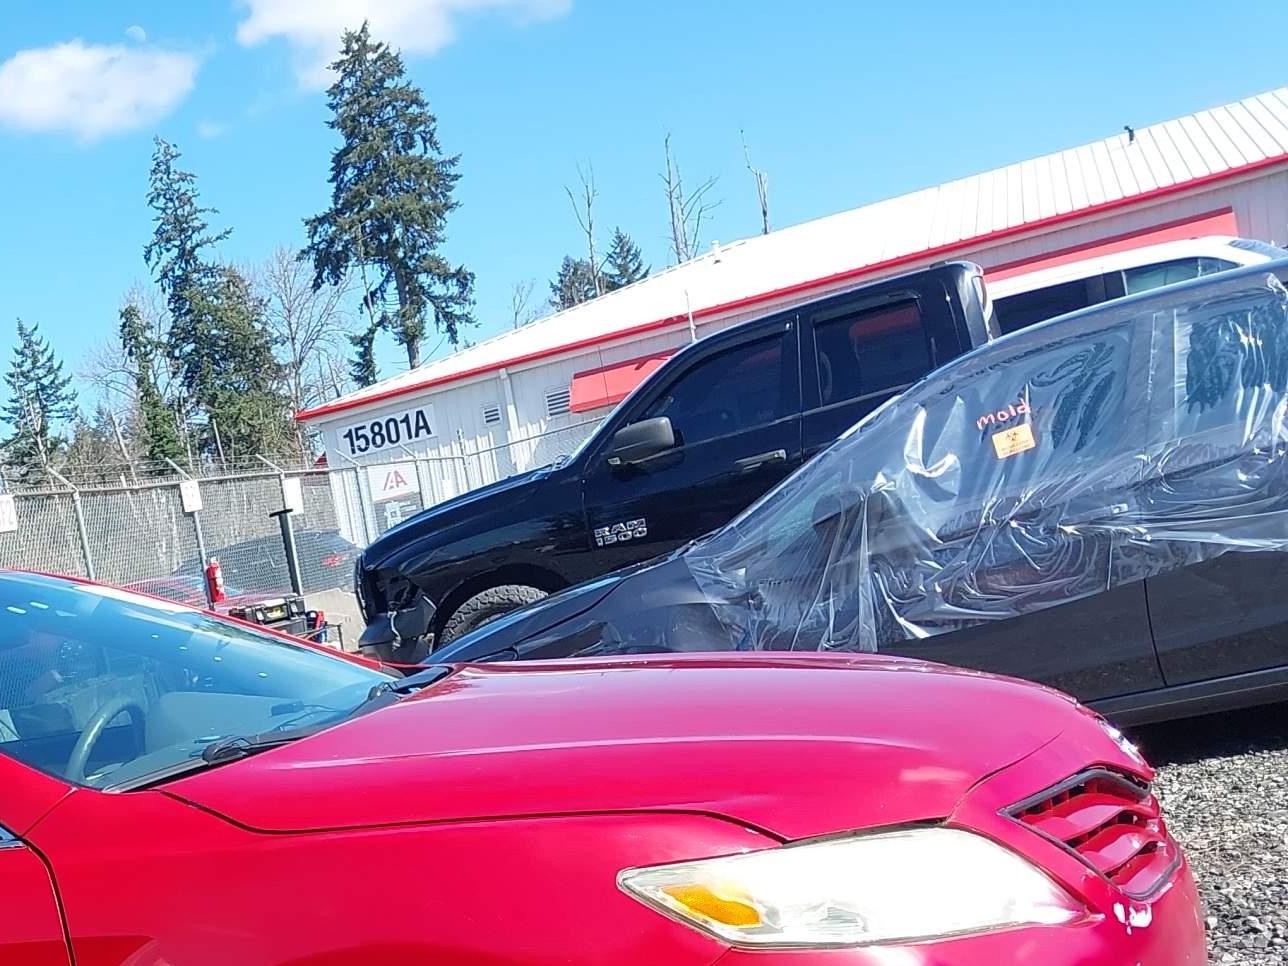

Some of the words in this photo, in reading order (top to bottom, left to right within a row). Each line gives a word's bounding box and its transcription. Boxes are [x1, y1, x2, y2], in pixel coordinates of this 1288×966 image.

[976, 398, 1031, 430] mold
[342, 409, 432, 455] 15801A
[594, 518, 646, 538] RAM
[595, 528, 648, 547] 1500
